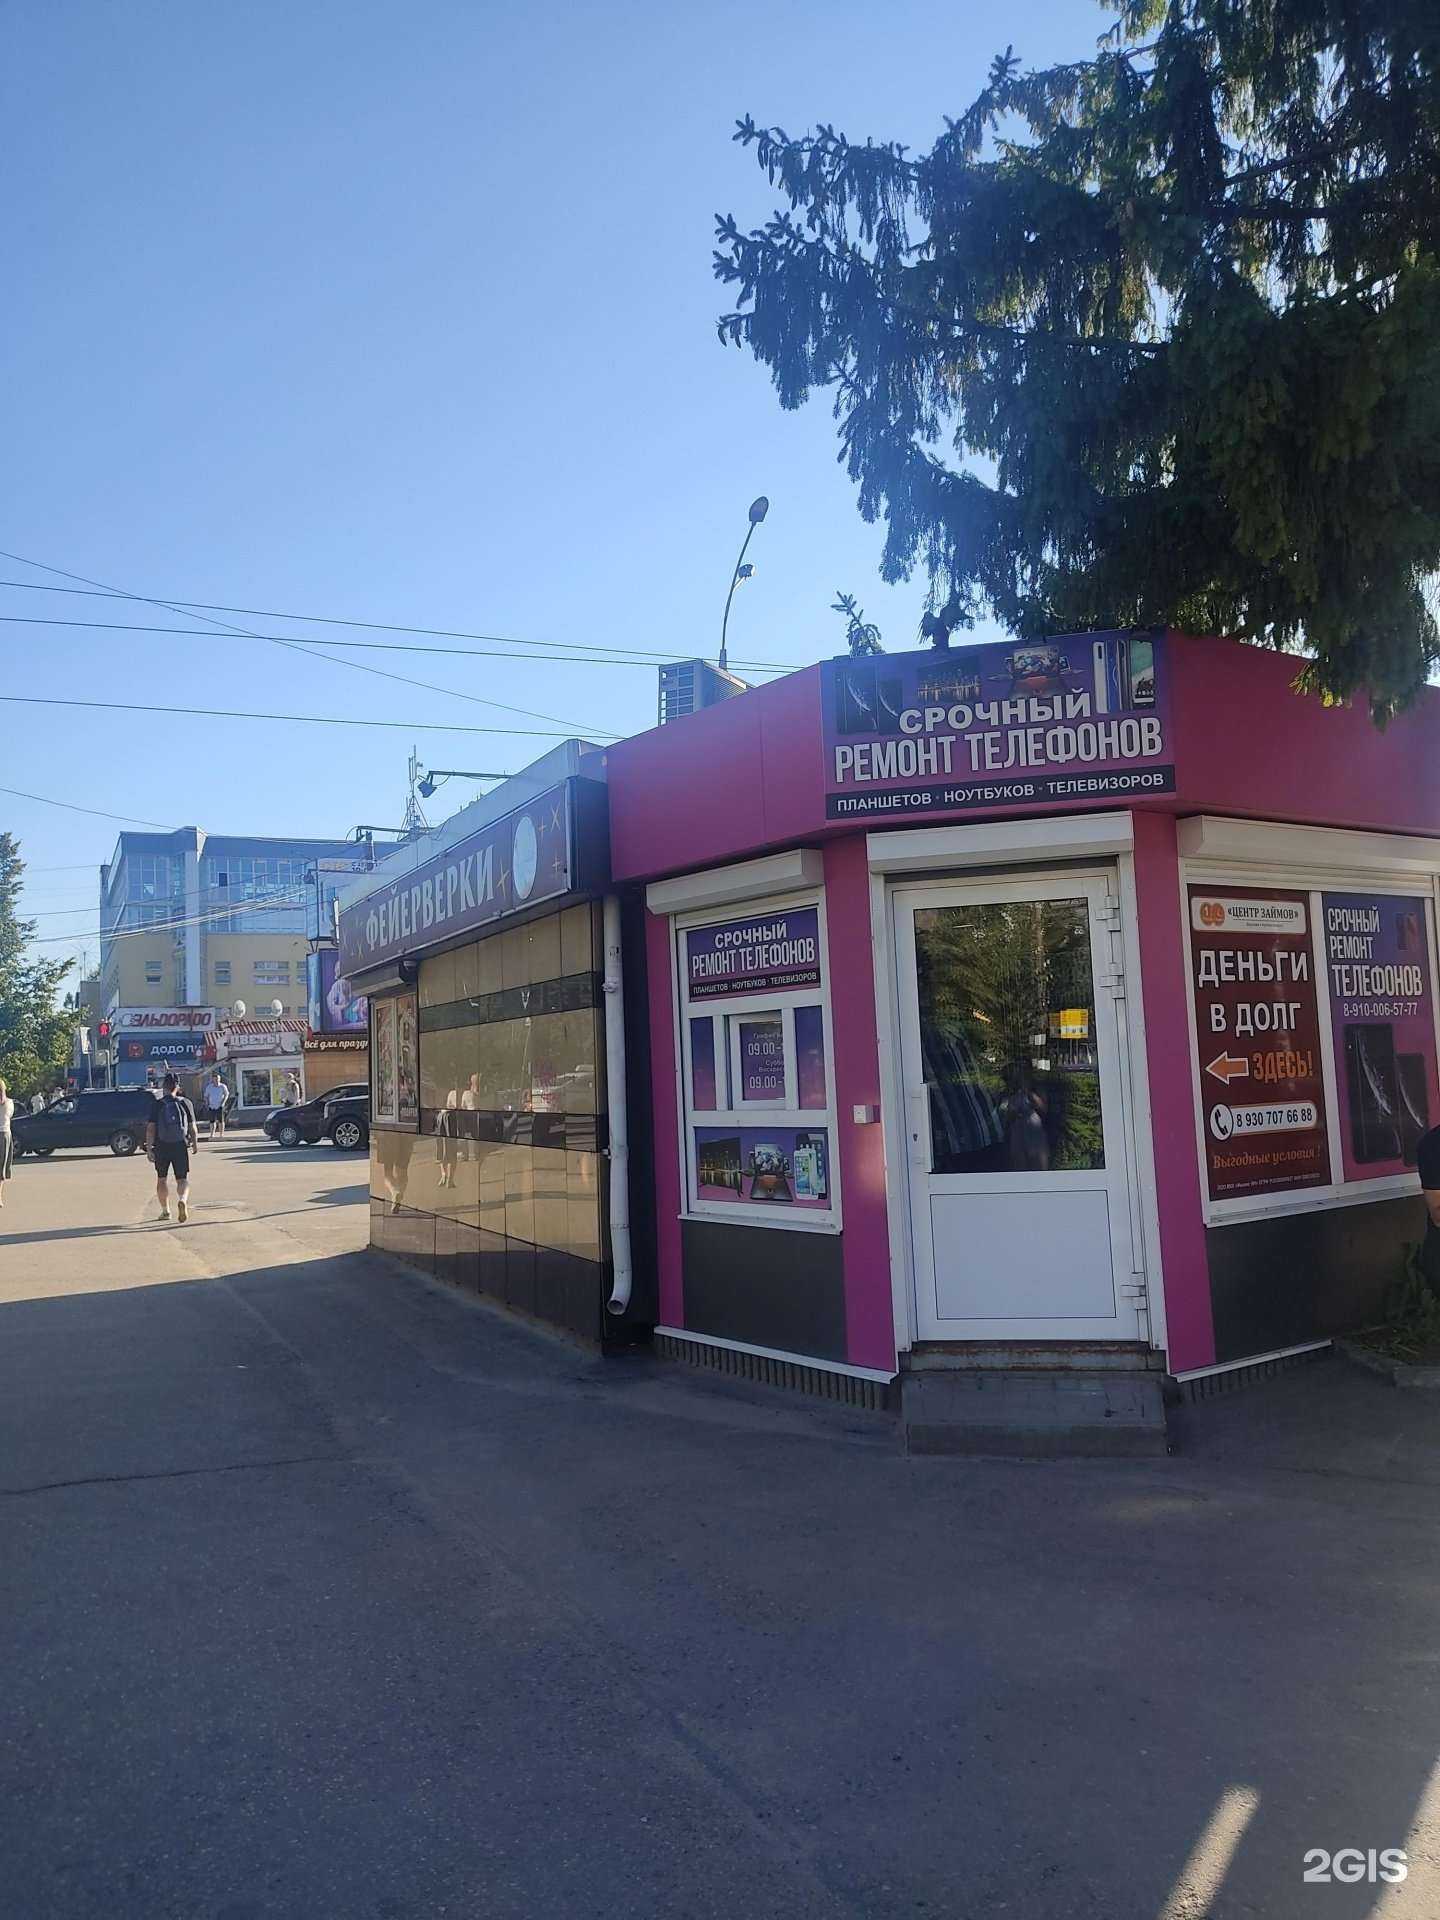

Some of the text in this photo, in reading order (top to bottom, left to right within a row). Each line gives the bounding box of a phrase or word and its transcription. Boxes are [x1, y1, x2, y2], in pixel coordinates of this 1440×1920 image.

[899, 687, 1092, 734] СРОЧНЫЙ
[835, 717, 1163, 783] РЕМОНТ ТЕЛЕФОНОВ
[836, 773, 1164, 812] ПЛАНШЕТОВ НОУТБУКОВ ТЕЛЕВИЗОРОВ
[365, 844, 495, 951] ФЕЙЕРВЕРКИ
[714, 919, 787, 948] СРОЧНЫЙ
[1328, 905, 1380, 933] СРОЧНЫЙ
[692, 937, 815, 978] РЕМОНТ ТЕЛЕФОНОВ
[1329, 935, 1374, 960] РЕМОНТ
[693, 971, 817, 995] ПЛАНШЕТОВ НОУТБУКОВ ТЕЛЕВИЗОРОВ
[1198, 950, 1308, 988] ДЕНЬГИ
[1331, 964, 1423, 997] ТЕЛЕФОНОВ
[1210, 1002, 1301, 1037] В ДОЛГ
[1343, 1002, 1418, 1017] 8-910-006-57-77
[150, 1044, 184, 1056] ДОДО
[320, 1041, 338, 1051] для
[1253, 1050, 1313, 1083] ЗДЕСЬ!
[1236, 1107, 1313, 1128] 8 930 707 66 88
